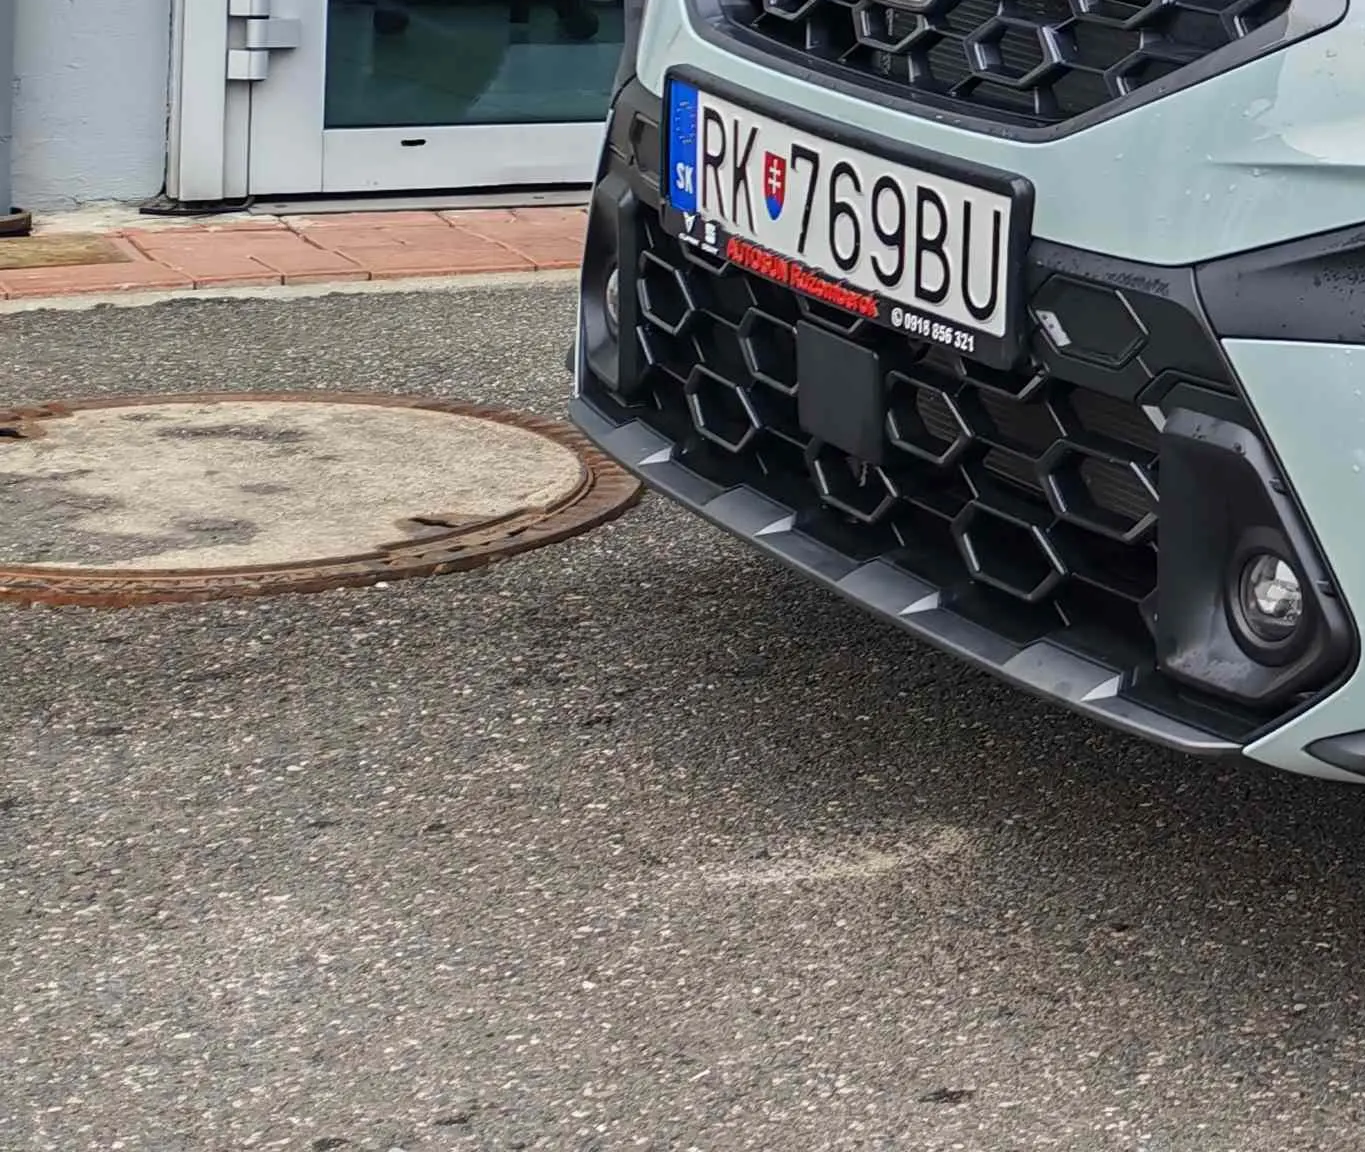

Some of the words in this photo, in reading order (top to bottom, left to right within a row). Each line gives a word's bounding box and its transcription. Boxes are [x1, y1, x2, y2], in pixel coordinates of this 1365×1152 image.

[675, 161, 694, 195] SK
[702, 105, 759, 236] RK
[790, 142, 1002, 322] 769BU
[904, 312, 930, 337] 0918
[932, 322, 953, 345] 856
[954, 330, 975, 353] 321
